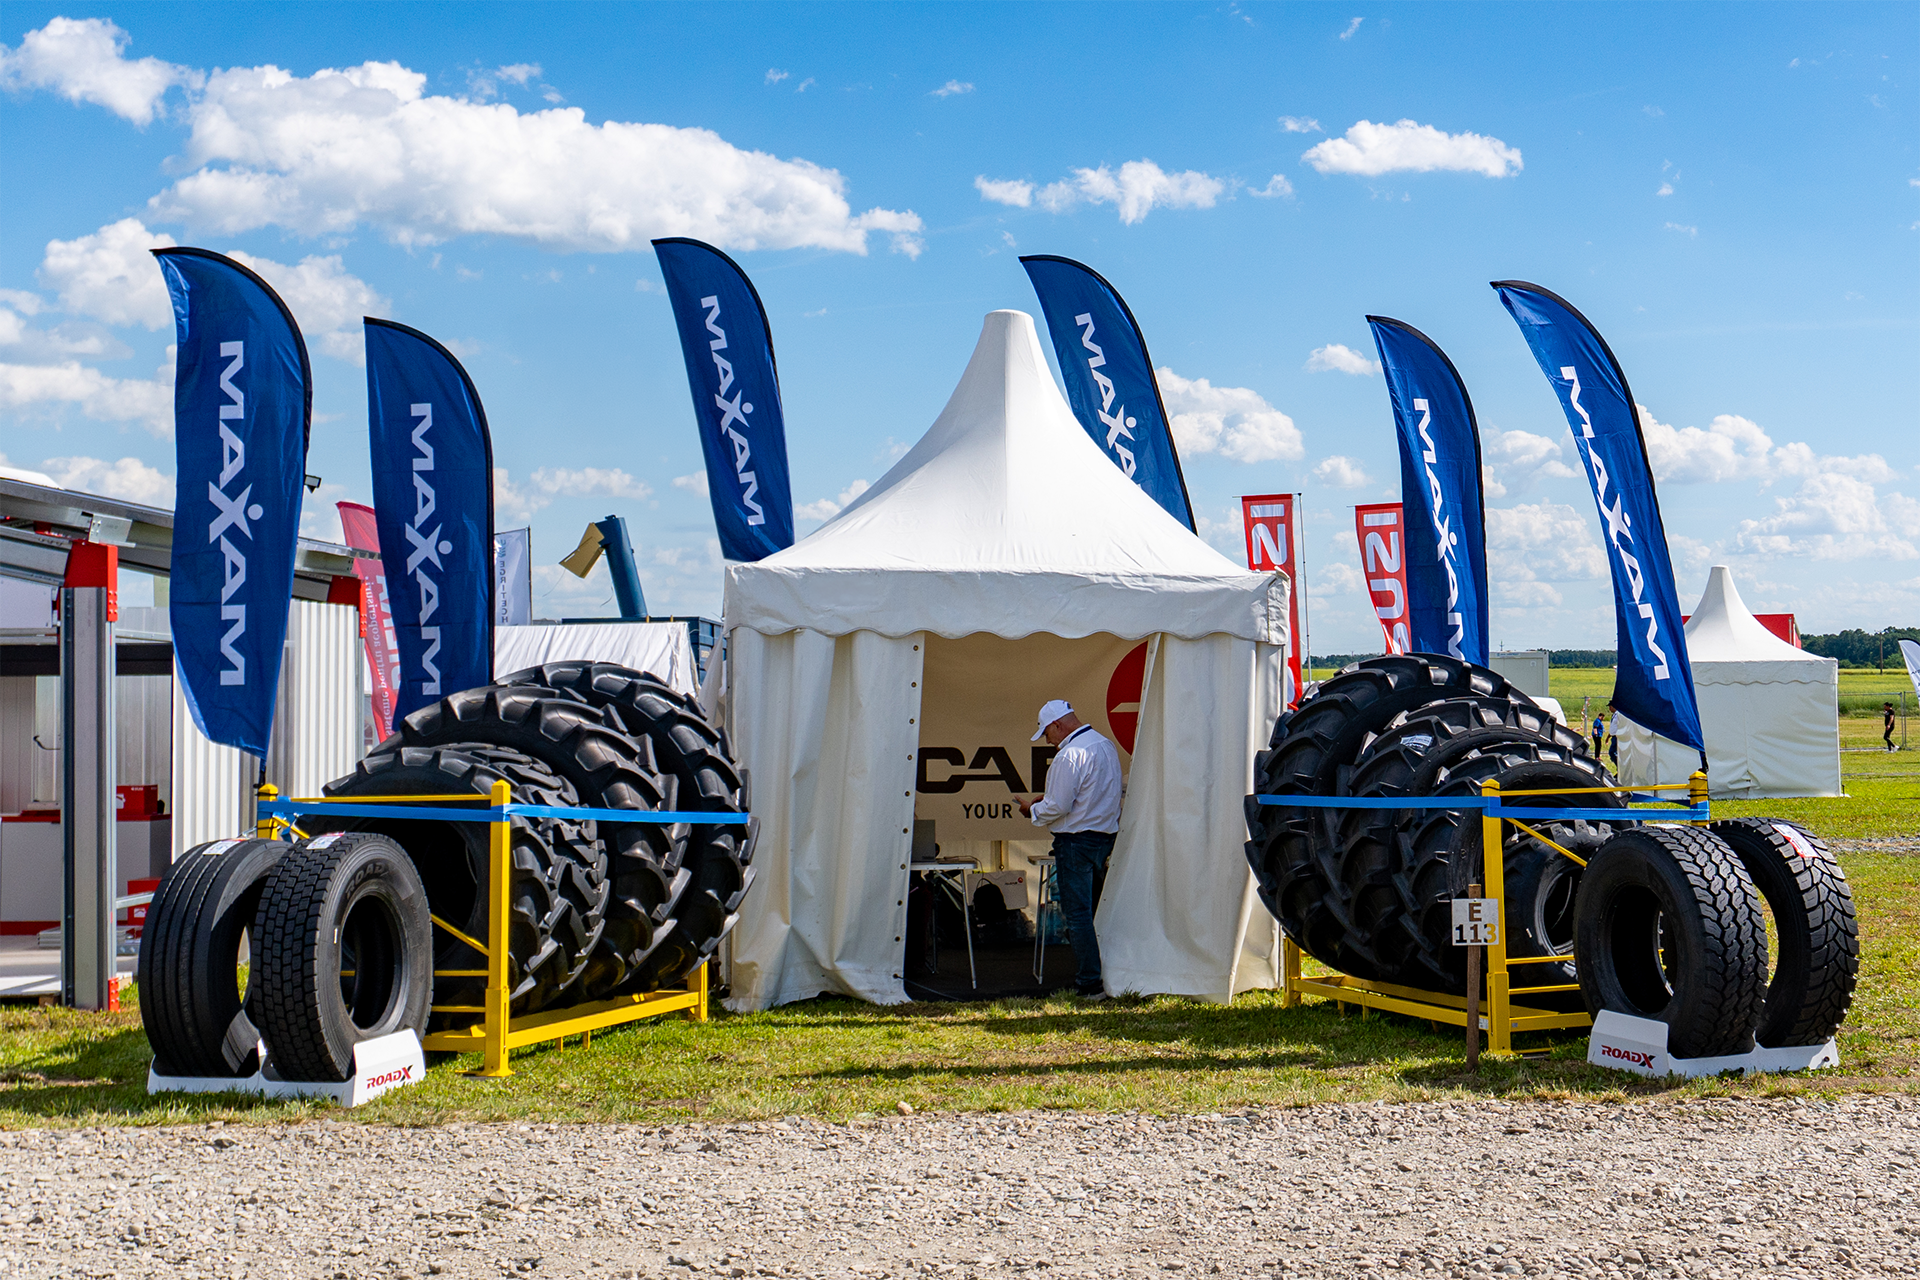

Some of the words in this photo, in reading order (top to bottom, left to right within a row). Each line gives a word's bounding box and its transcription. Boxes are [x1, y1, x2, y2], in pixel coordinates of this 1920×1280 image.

[700, 295, 766, 526] MAXAM
[1075, 312, 1142, 490] MAXA
[208, 341, 263, 686] MAXAM
[405, 403, 452, 695] MAXAM
[1560, 366, 1671, 681] MAXAM
[962, 803, 1013, 819] YOUR
[1455, 923, 1497, 943] 113
[1469, 902, 1482, 922] E
[366, 1064, 413, 1089] ROADX
[1601, 1044, 1656, 1070] ROADX
